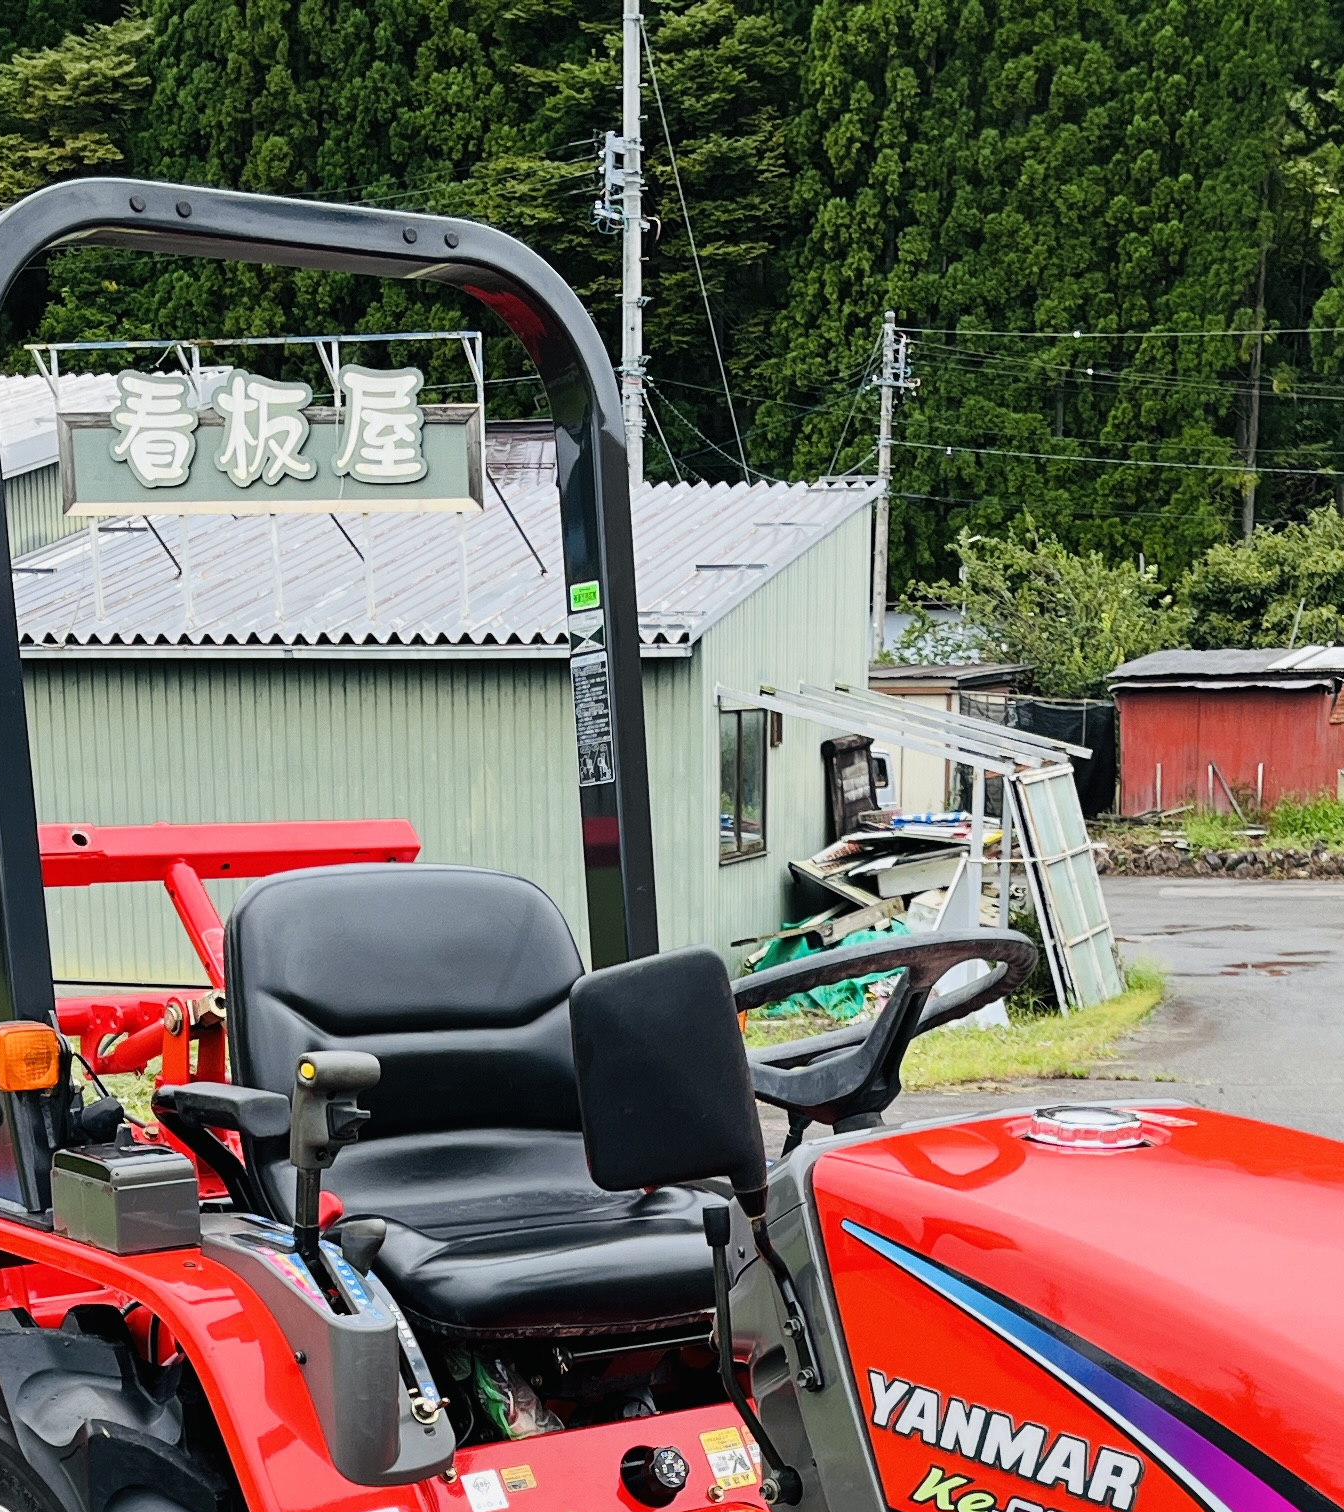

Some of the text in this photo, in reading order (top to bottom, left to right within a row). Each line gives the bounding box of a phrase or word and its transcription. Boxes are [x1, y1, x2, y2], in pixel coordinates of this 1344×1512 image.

[113, 372, 423, 481] 看板屋
[868, 1369, 1144, 1512] YANMAR
